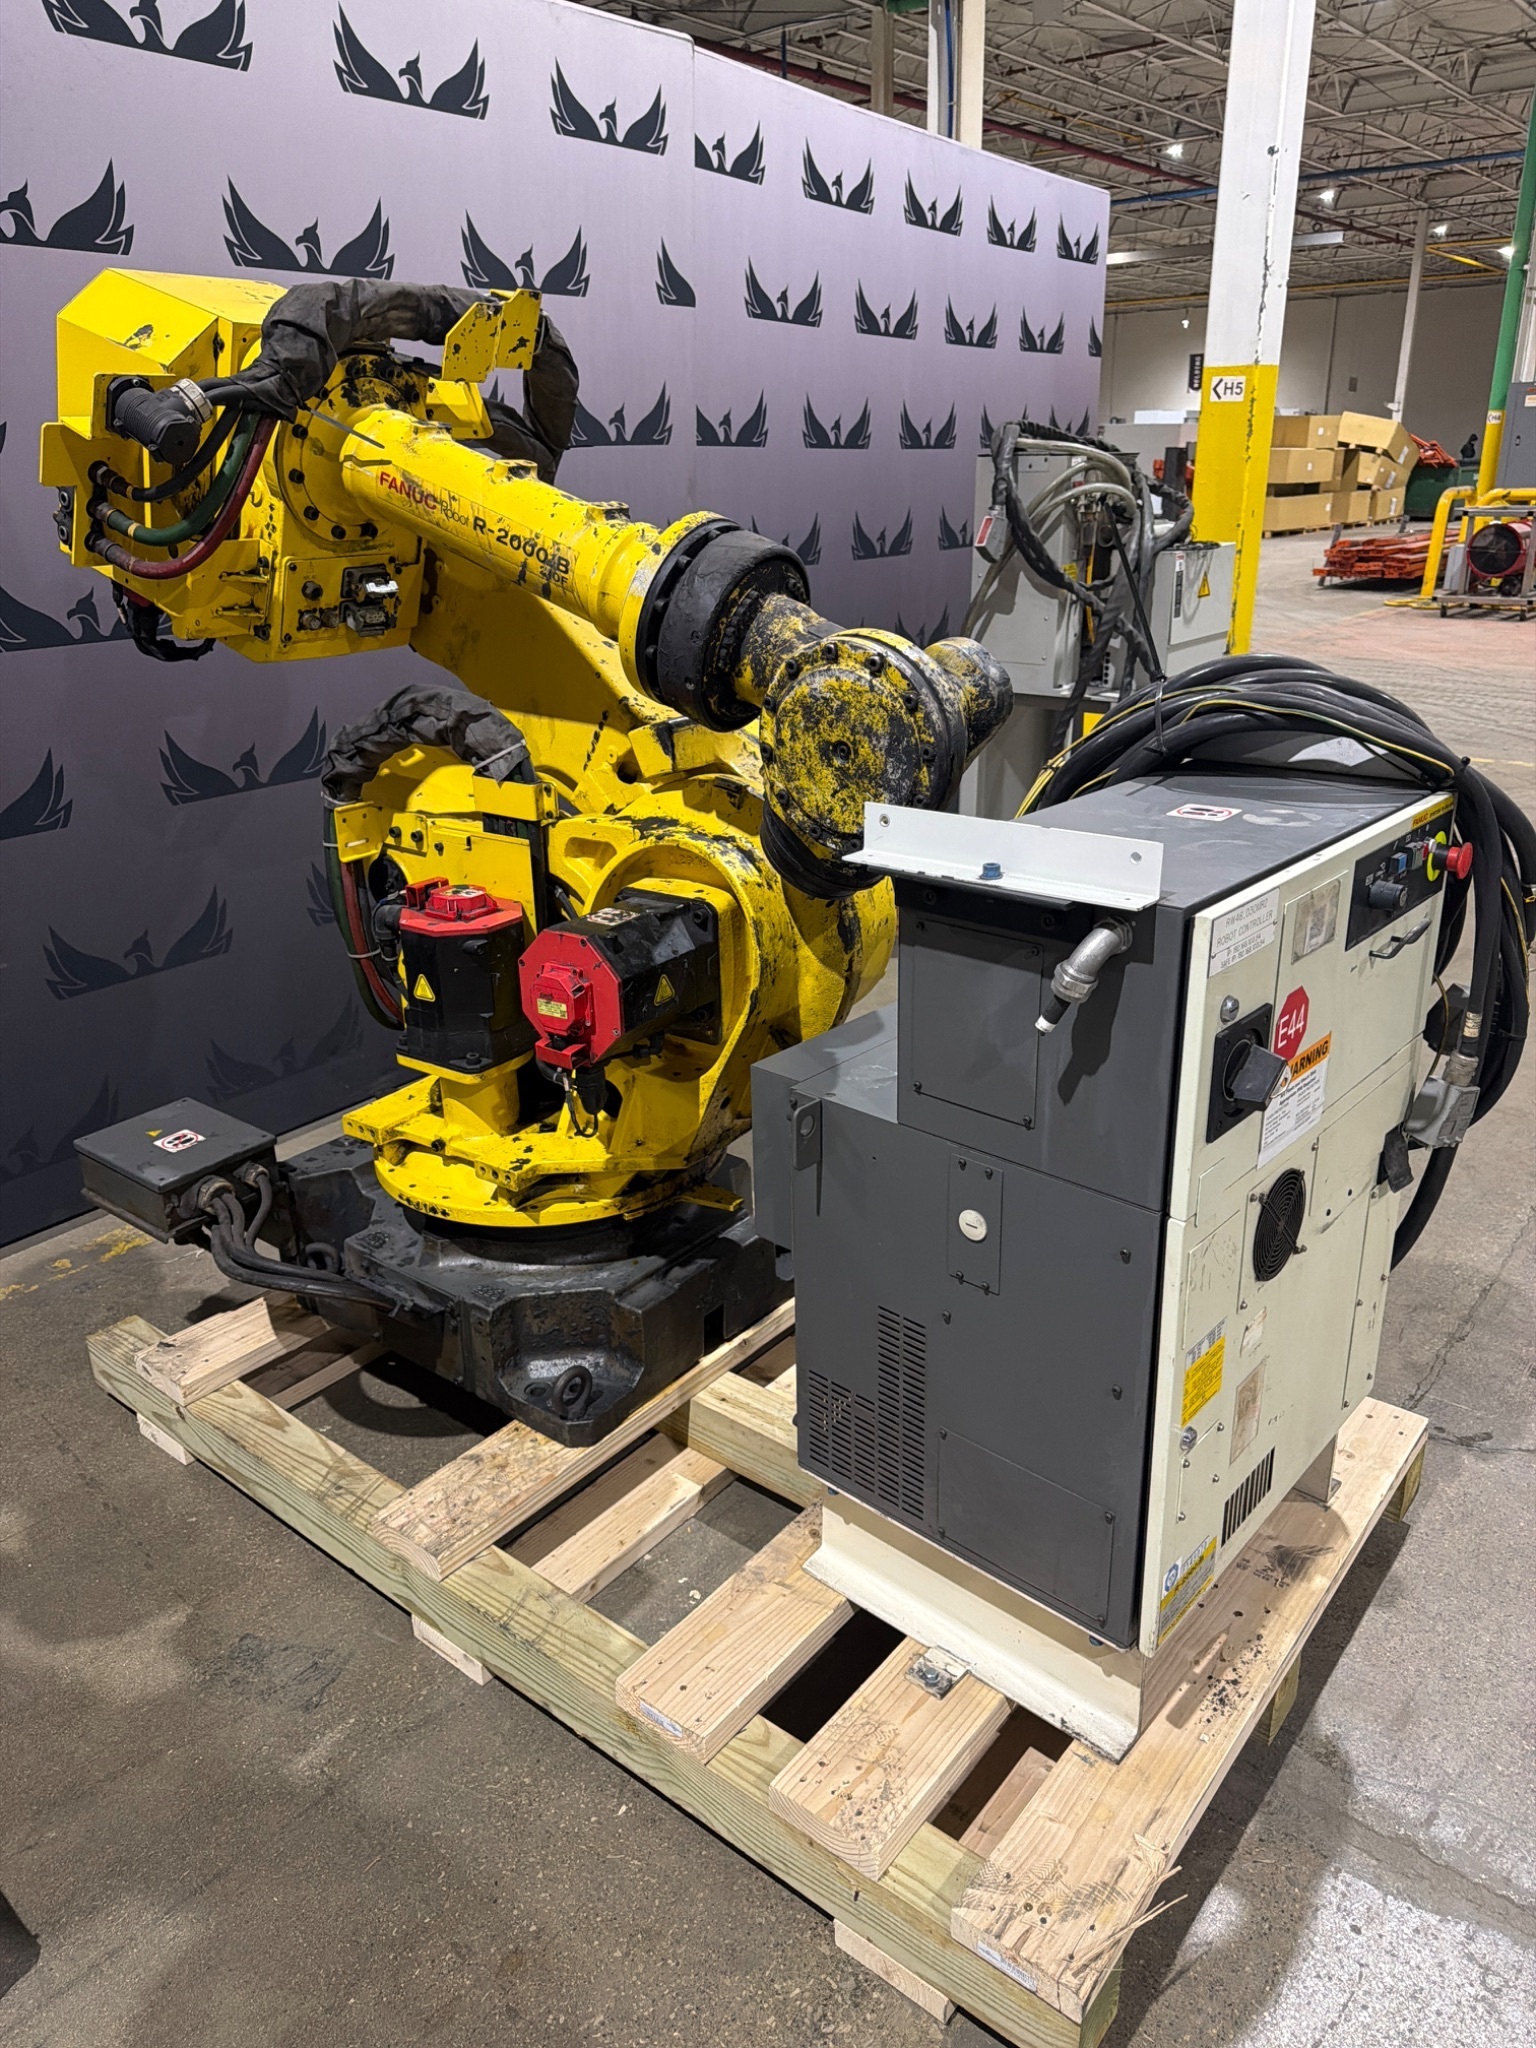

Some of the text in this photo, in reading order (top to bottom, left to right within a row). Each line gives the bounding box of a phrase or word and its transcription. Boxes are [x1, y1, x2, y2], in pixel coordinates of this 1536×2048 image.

[1223, 381, 1244, 396] H5
[380, 471, 570, 575] FANUC Robot R-2000B
[540, 565, 569, 585] 20F
[1412, 812, 1429, 828] FANUC
[1216, 910, 1274, 948] ROBOT CONTROLLER
[1220, 957, 1231, 969] SAFE
[1277, 1003, 1305, 1049] E44
